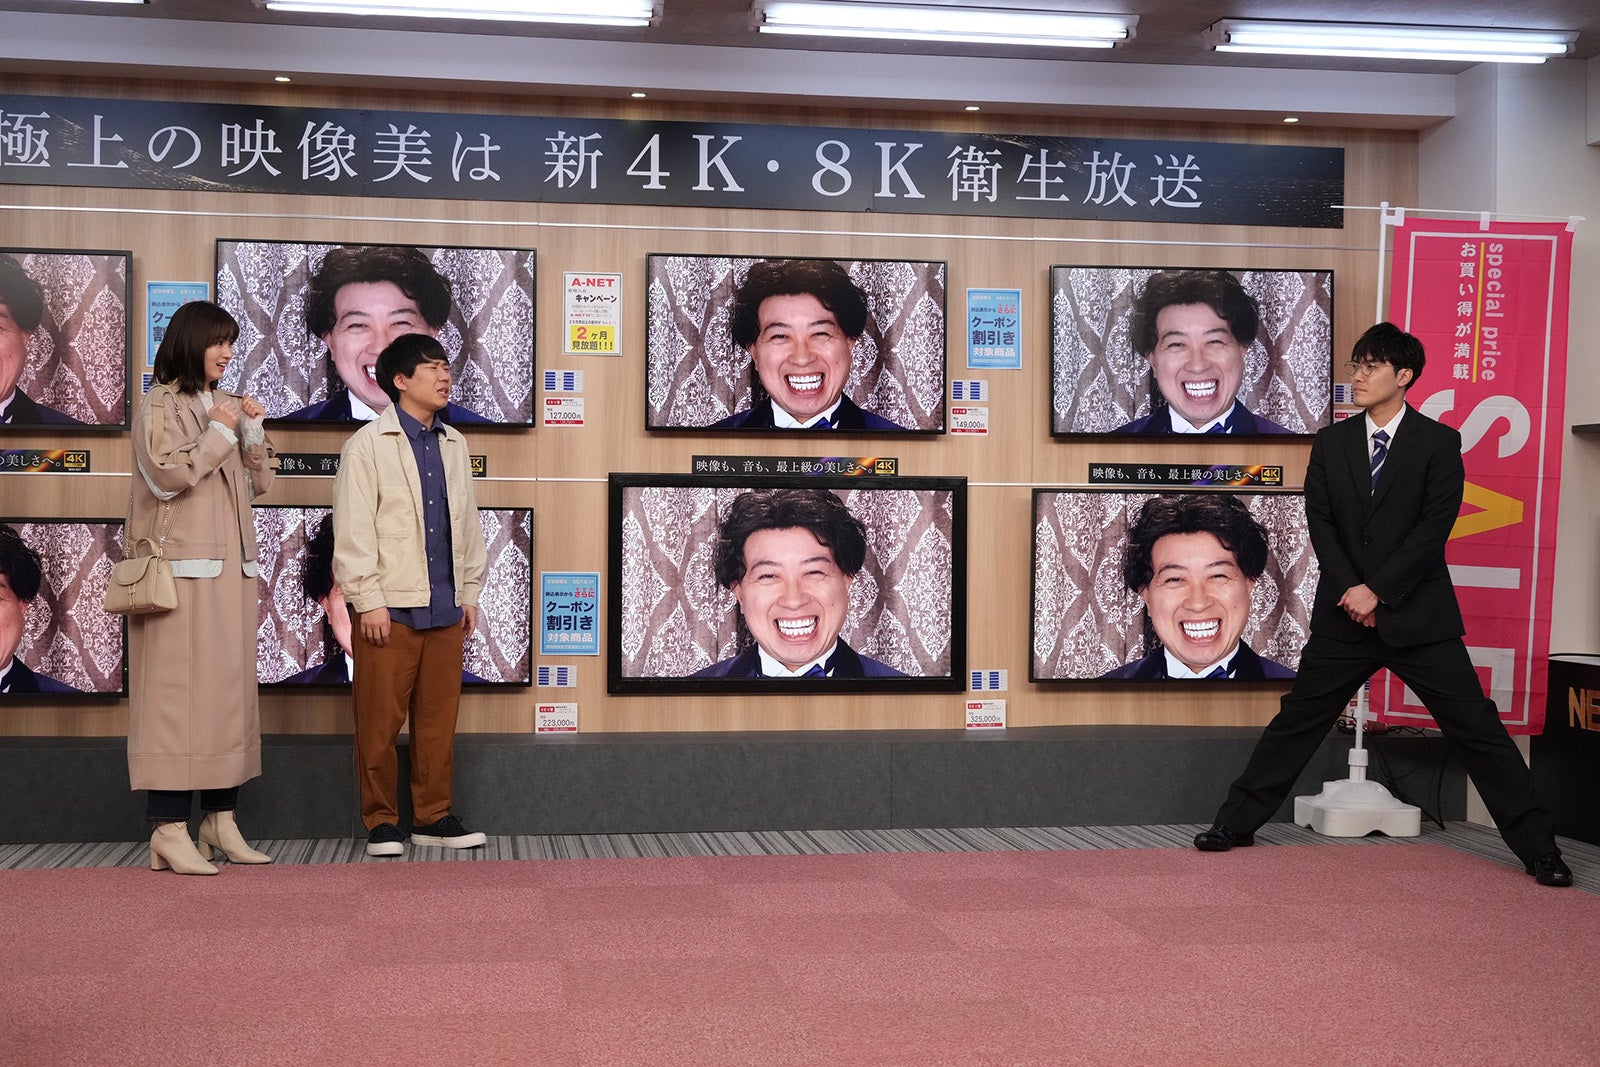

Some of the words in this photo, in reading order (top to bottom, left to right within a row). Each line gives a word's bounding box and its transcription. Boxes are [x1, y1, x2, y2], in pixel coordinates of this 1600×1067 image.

[571, 277, 615, 288] A-NET
[1485, 242, 1505, 318] special
[575, 293, 617, 303] キャンペーン
[1452, 242, 1477, 380] お買い得が満載
[971, 316, 1017, 328] クーポン
[971, 330, 1016, 346] 割引き
[973, 347, 1016, 357] 対象商品
[1481, 326, 1501, 381] price
[66, 454, 84, 463] 4K
[877, 460, 893, 471] 4K
[1262, 468, 1279, 479] 4K
[546, 601, 595, 613] クーポン
[546, 614, 594, 631] 割引き
[547, 632, 593, 643] 対象商品
